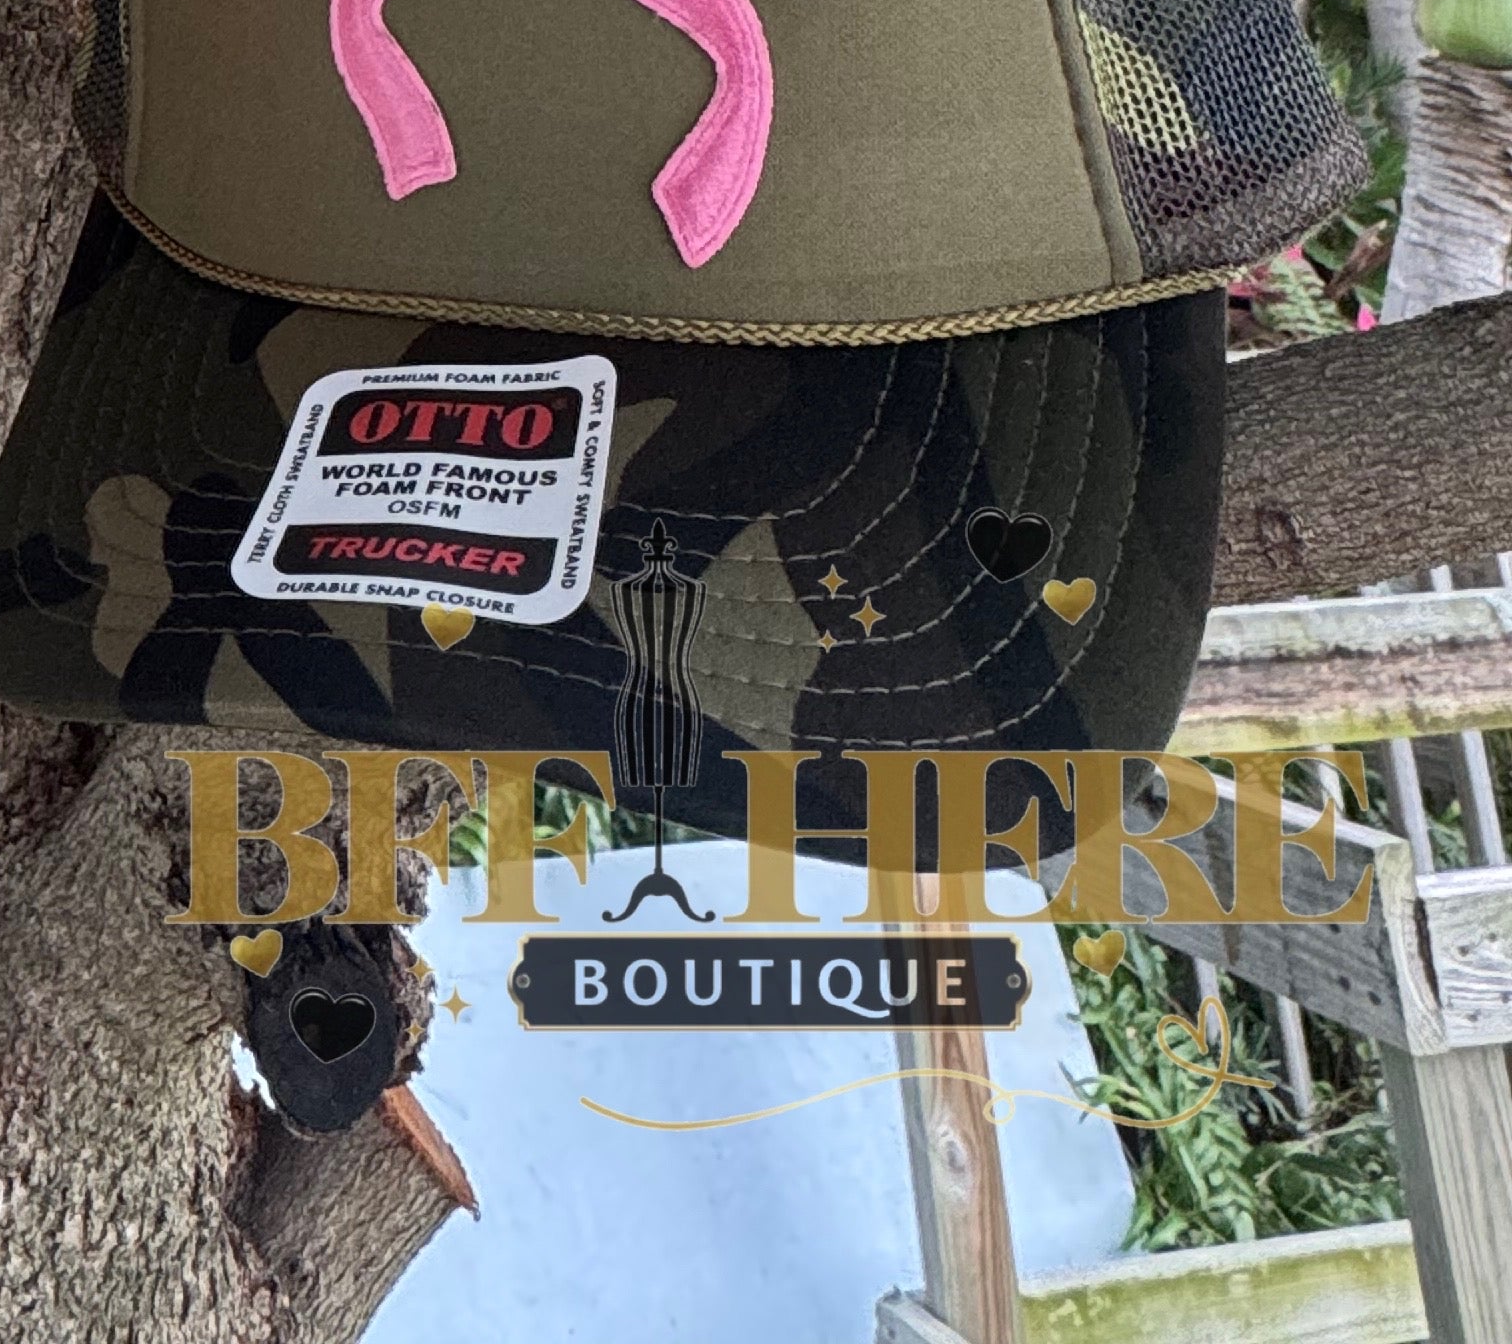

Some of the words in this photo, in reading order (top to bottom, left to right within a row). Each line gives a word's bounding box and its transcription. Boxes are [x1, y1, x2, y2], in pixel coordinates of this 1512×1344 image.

[362, 372, 439, 385] PREMIUM
[445, 372, 496, 384] FOAM
[502, 370, 562, 384] FABRIC
[590, 380, 605, 415] SOFT
[349, 399, 554, 450] OTTO
[587, 420, 601, 432] &
[321, 462, 421, 481] WORLD
[431, 463, 558, 487] FAMOUS
[579, 436, 599, 488] COMFY
[267, 485, 295, 524] CLOTH
[335, 480, 416, 497] FOAM
[425, 482, 532, 506] FRONT
[388, 500, 462, 520] OSFM
[307, 536, 528, 578] TRUCKER
[561, 494, 590, 590] SWEATBAND
[276, 581, 360, 596] DURABLE
[365, 583, 420, 599] SNAP
[426, 589, 516, 614] CLOSURE
